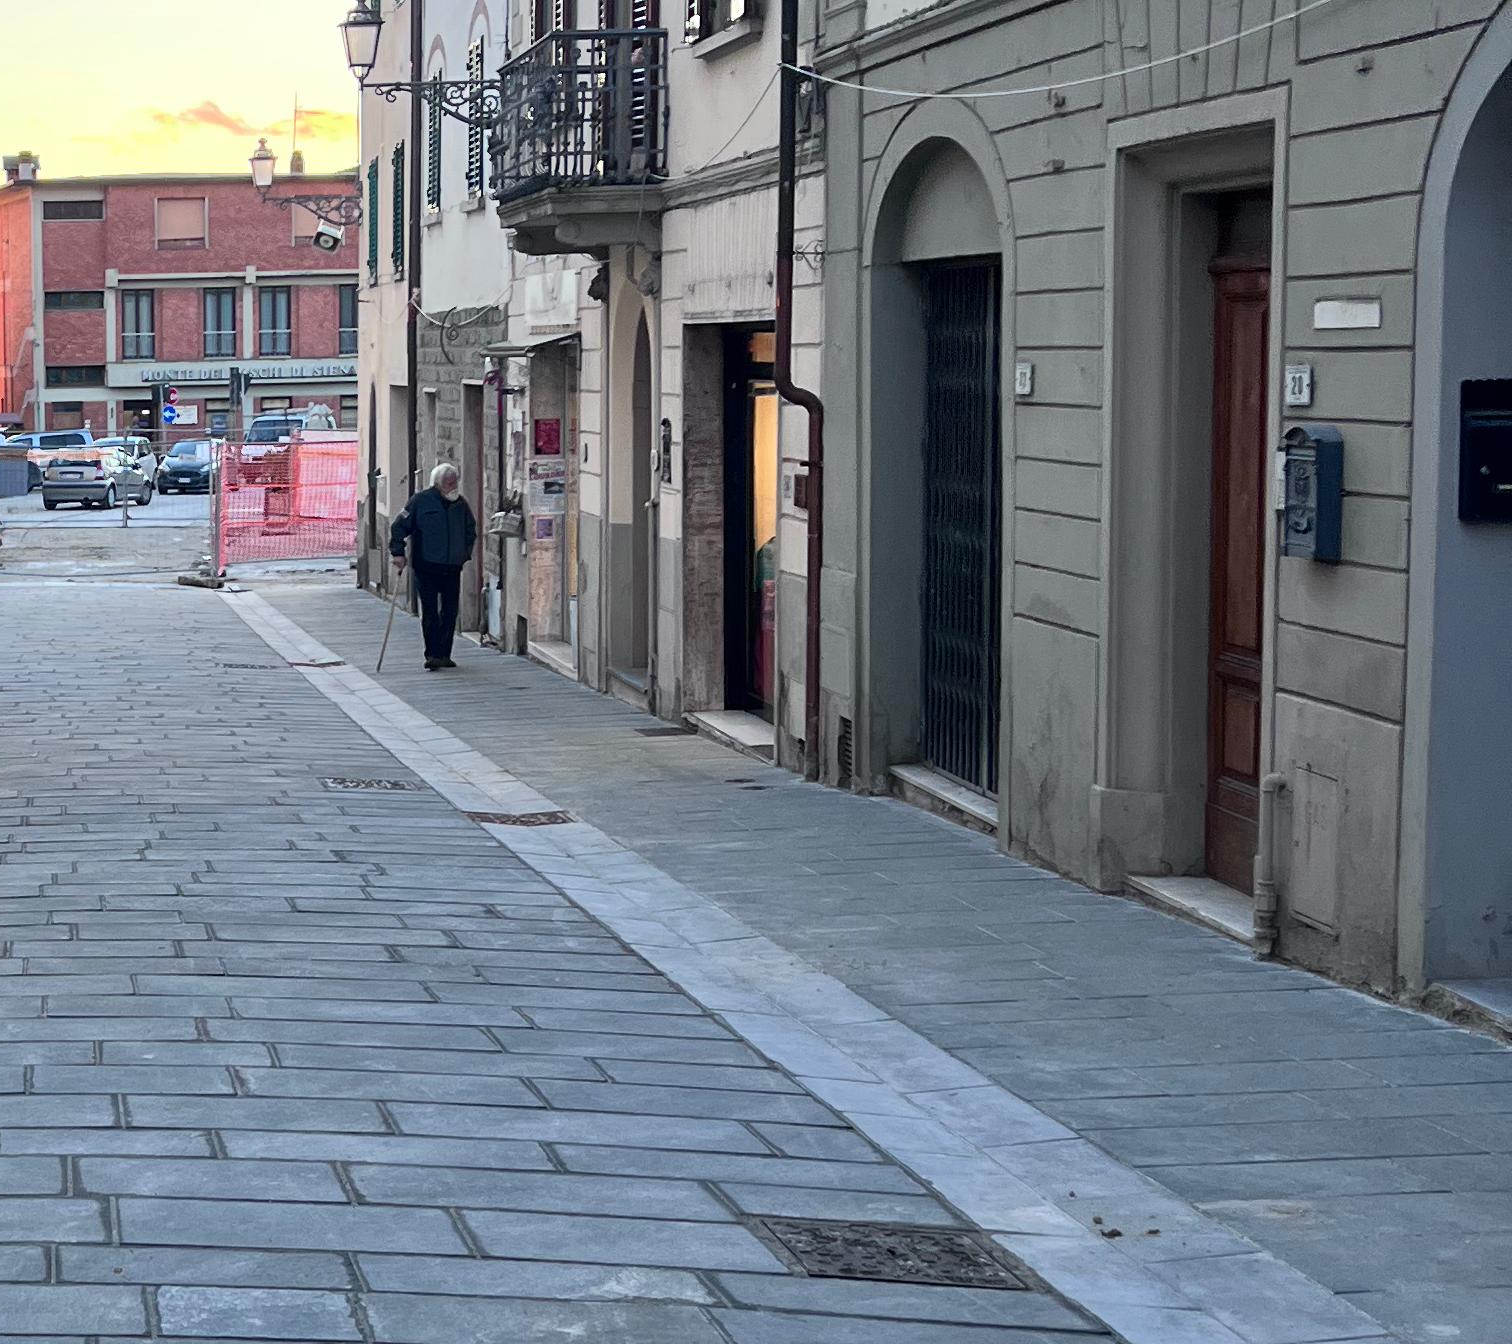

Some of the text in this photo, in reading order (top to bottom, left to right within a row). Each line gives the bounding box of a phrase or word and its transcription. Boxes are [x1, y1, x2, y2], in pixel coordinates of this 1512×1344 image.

[141, 369, 192, 381] MONTE
[290, 367, 304, 377] DI
[312, 365, 356, 377] SIENA
